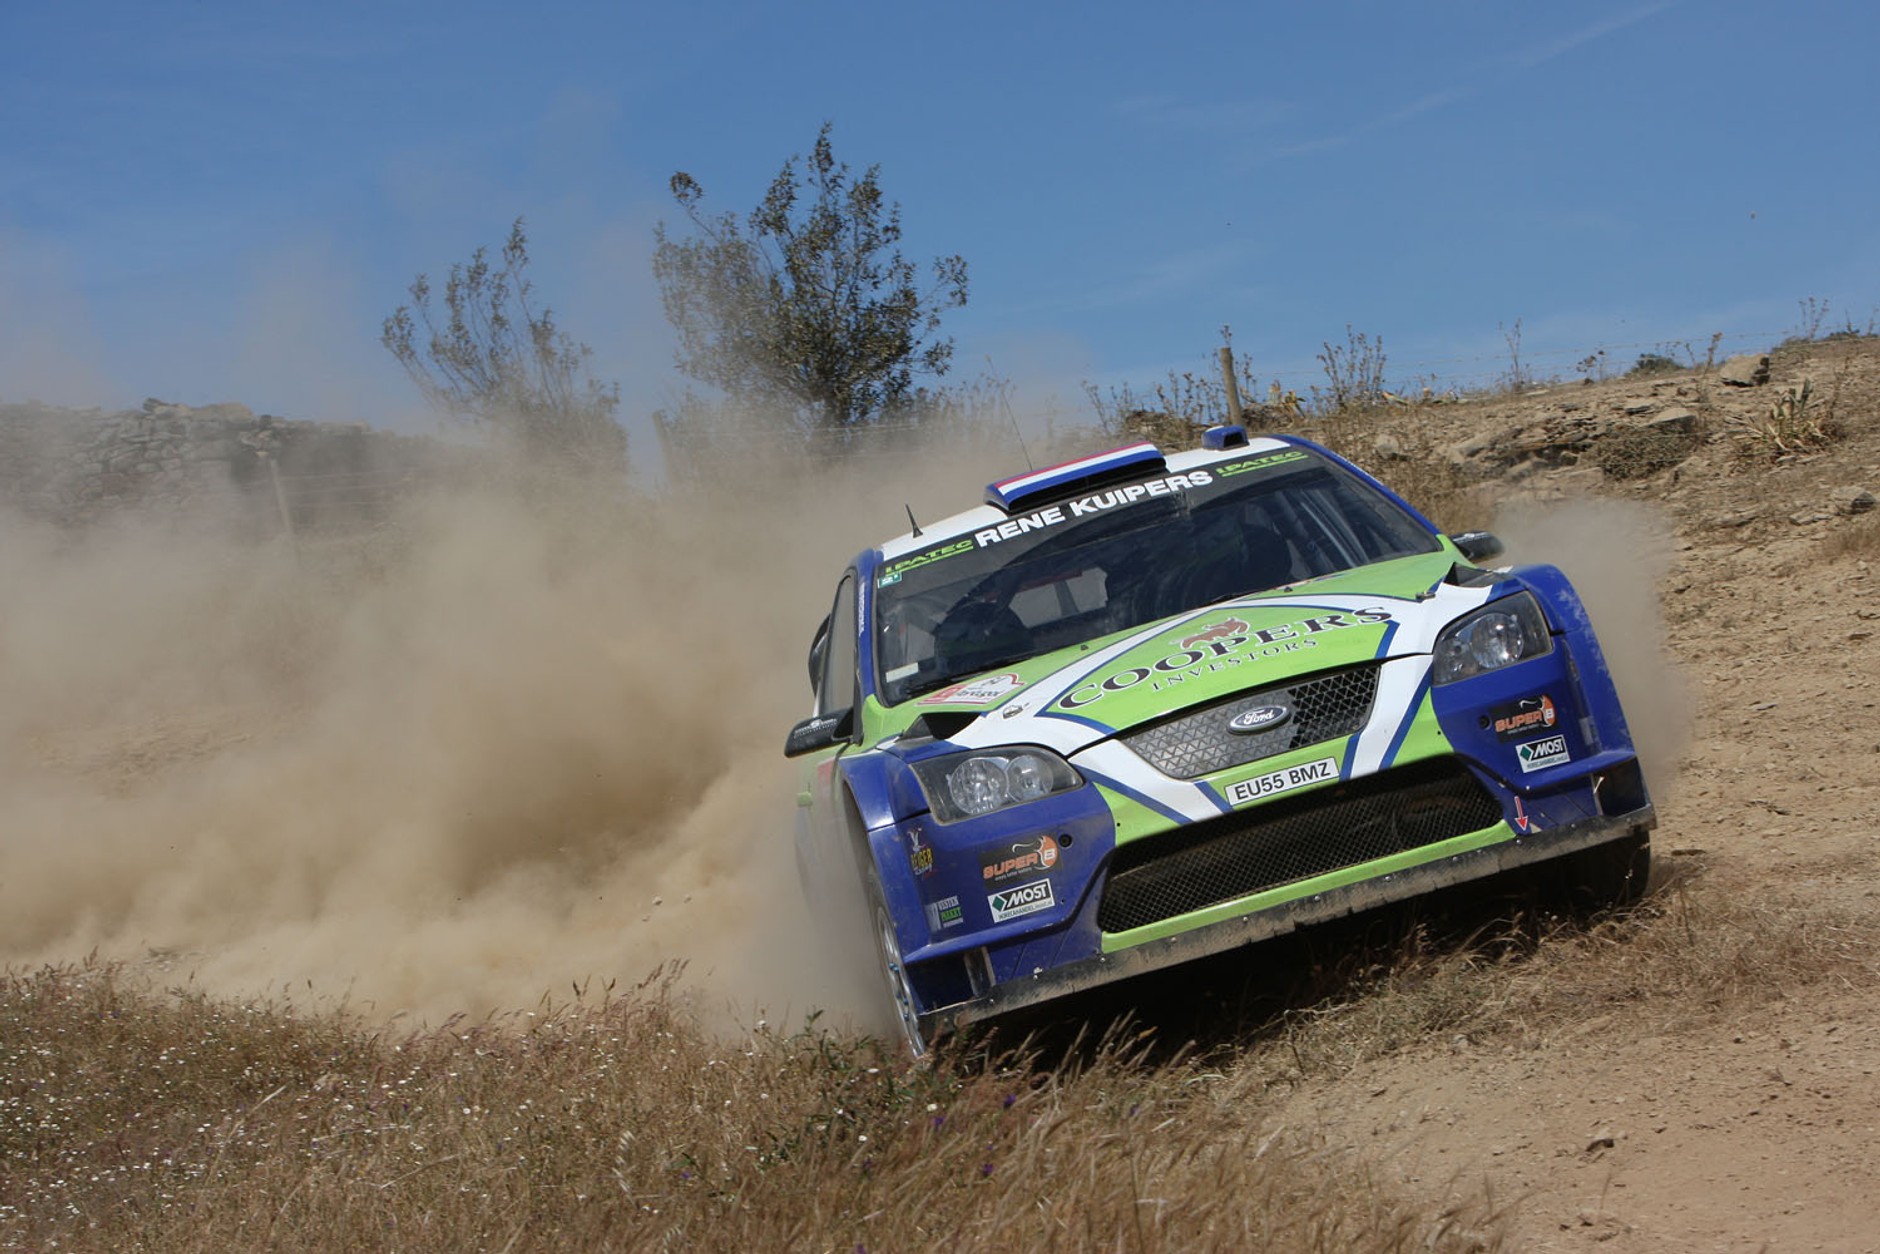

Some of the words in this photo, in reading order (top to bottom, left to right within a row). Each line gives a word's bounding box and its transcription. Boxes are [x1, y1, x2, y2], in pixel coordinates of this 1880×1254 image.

[974, 506, 1066, 548] RENE
[1069, 470, 1214, 517] KUIPERS
[1058, 607, 1394, 710] COOPERS
[1151, 638, 1319, 692] INVESTORS
[1242, 708, 1275, 725] Ford
[1494, 710, 1543, 733] SUPER
[1545, 708, 1554, 720] B
[1533, 738, 1563, 759] MOST
[1234, 774, 1285, 801] EU55
[1288, 762, 1331, 785] BMZ
[982, 852, 1038, 880] SUPER
[1044, 848, 1056, 860] B
[1006, 883, 1048, 909] MOST
